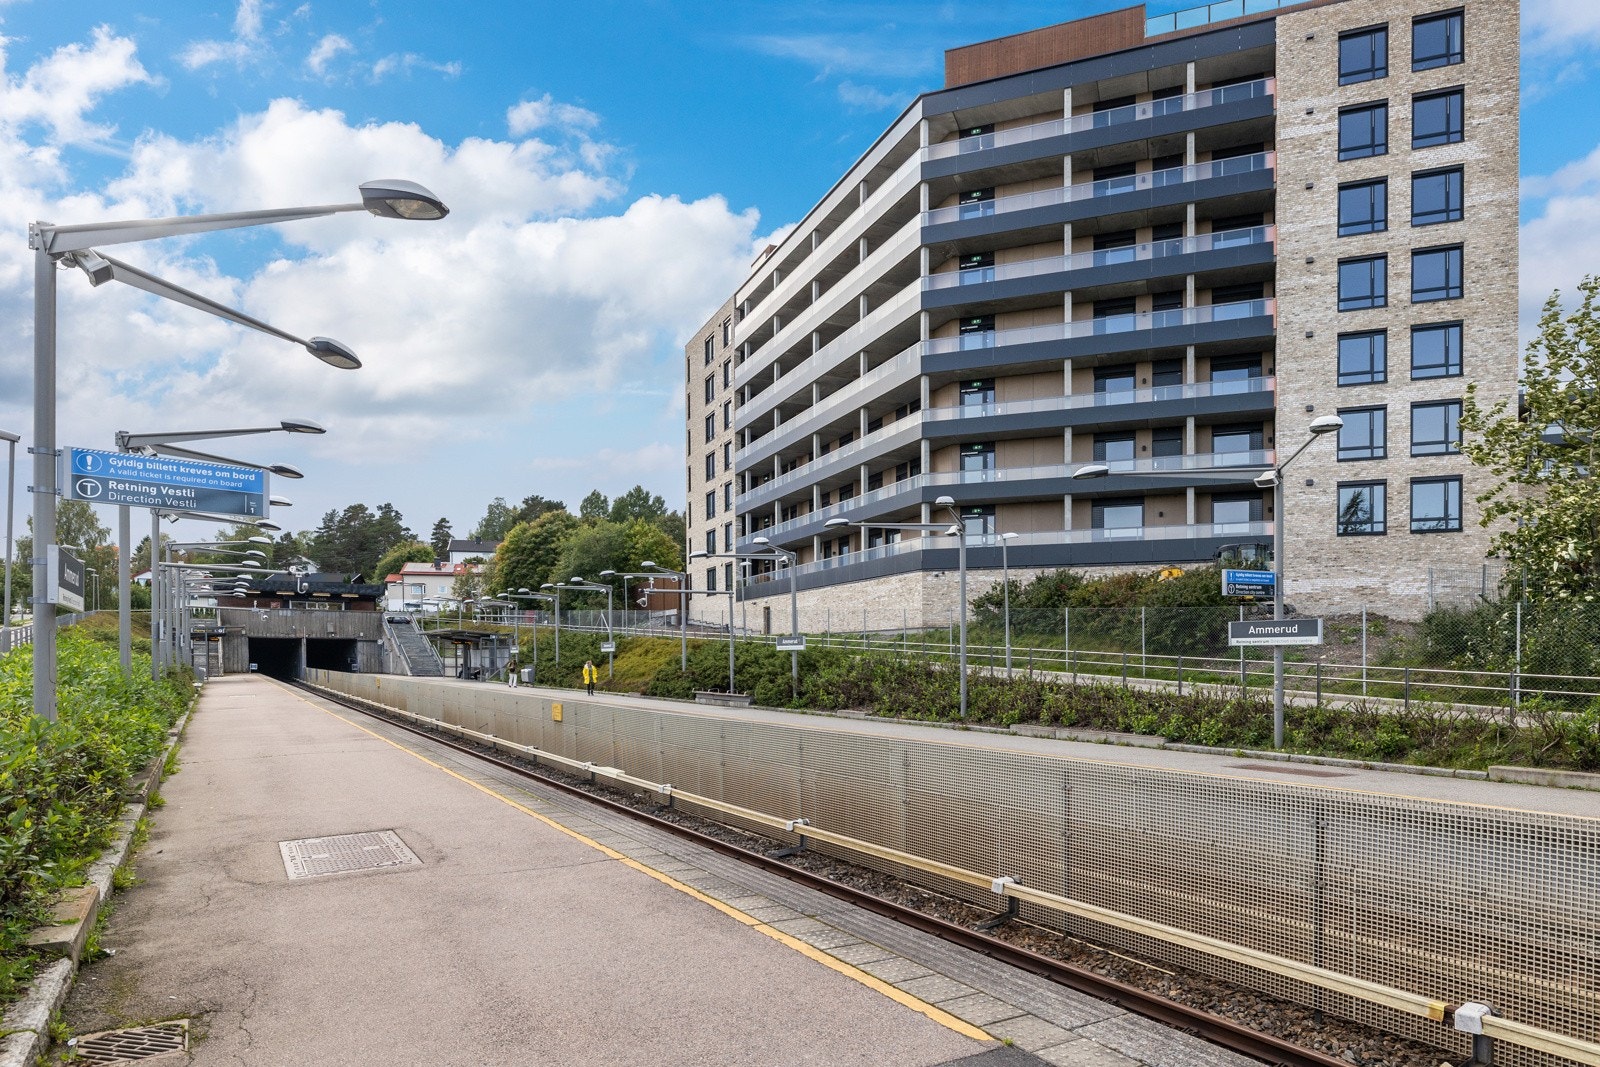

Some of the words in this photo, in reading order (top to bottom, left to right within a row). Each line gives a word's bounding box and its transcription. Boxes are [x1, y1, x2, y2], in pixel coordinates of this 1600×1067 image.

[109, 457, 143, 470] Gyldig
[146, 461, 177, 472] billett
[180, 465, 213, 477] kreves
[215, 470, 230, 478] om
[232, 471, 255, 481] bord
[116, 469, 137, 477] valid
[139, 471, 162, 479] ticket
[173, 474, 207, 484] required
[220, 479, 243, 488] board
[109, 480, 157, 495] Retning
[160, 485, 195, 498] Vestli
[108, 491, 161, 505] Direction
[165, 496, 197, 508] Vestli
[1248, 624, 1298, 635] Ammerud
